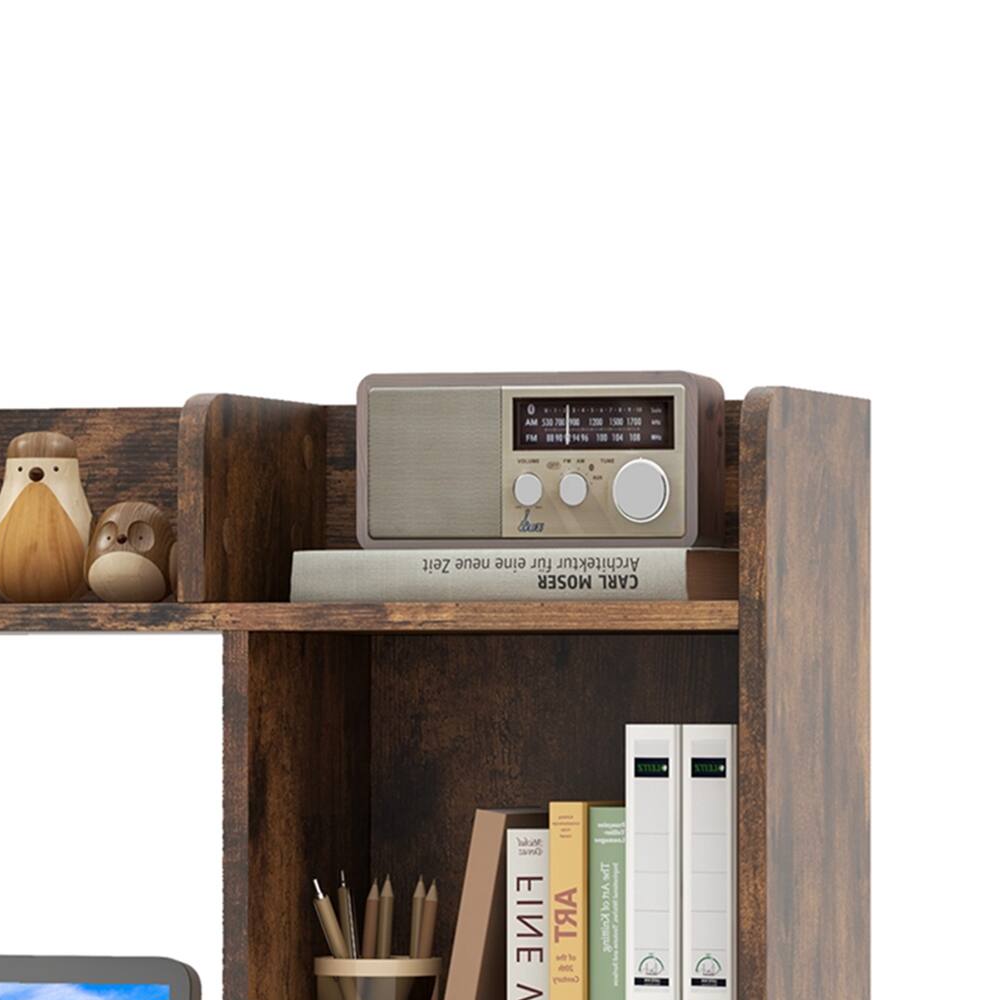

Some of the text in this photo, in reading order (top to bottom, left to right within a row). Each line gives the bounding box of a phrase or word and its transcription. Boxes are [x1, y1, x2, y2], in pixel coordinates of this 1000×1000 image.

[524, 418, 538, 426] AM
[588, 417, 603, 426] 1200
[609, 417, 624, 426] 1500
[626, 416, 642, 426] 1700
[525, 434, 538, 442] FM
[596, 433, 608, 442] 100
[611, 433, 624, 442] 104
[629, 433, 641, 442] 108
[422, 557, 640, 574] Architektur für eine neue Zeit
[537, 575, 639, 590] CARL MOSER
